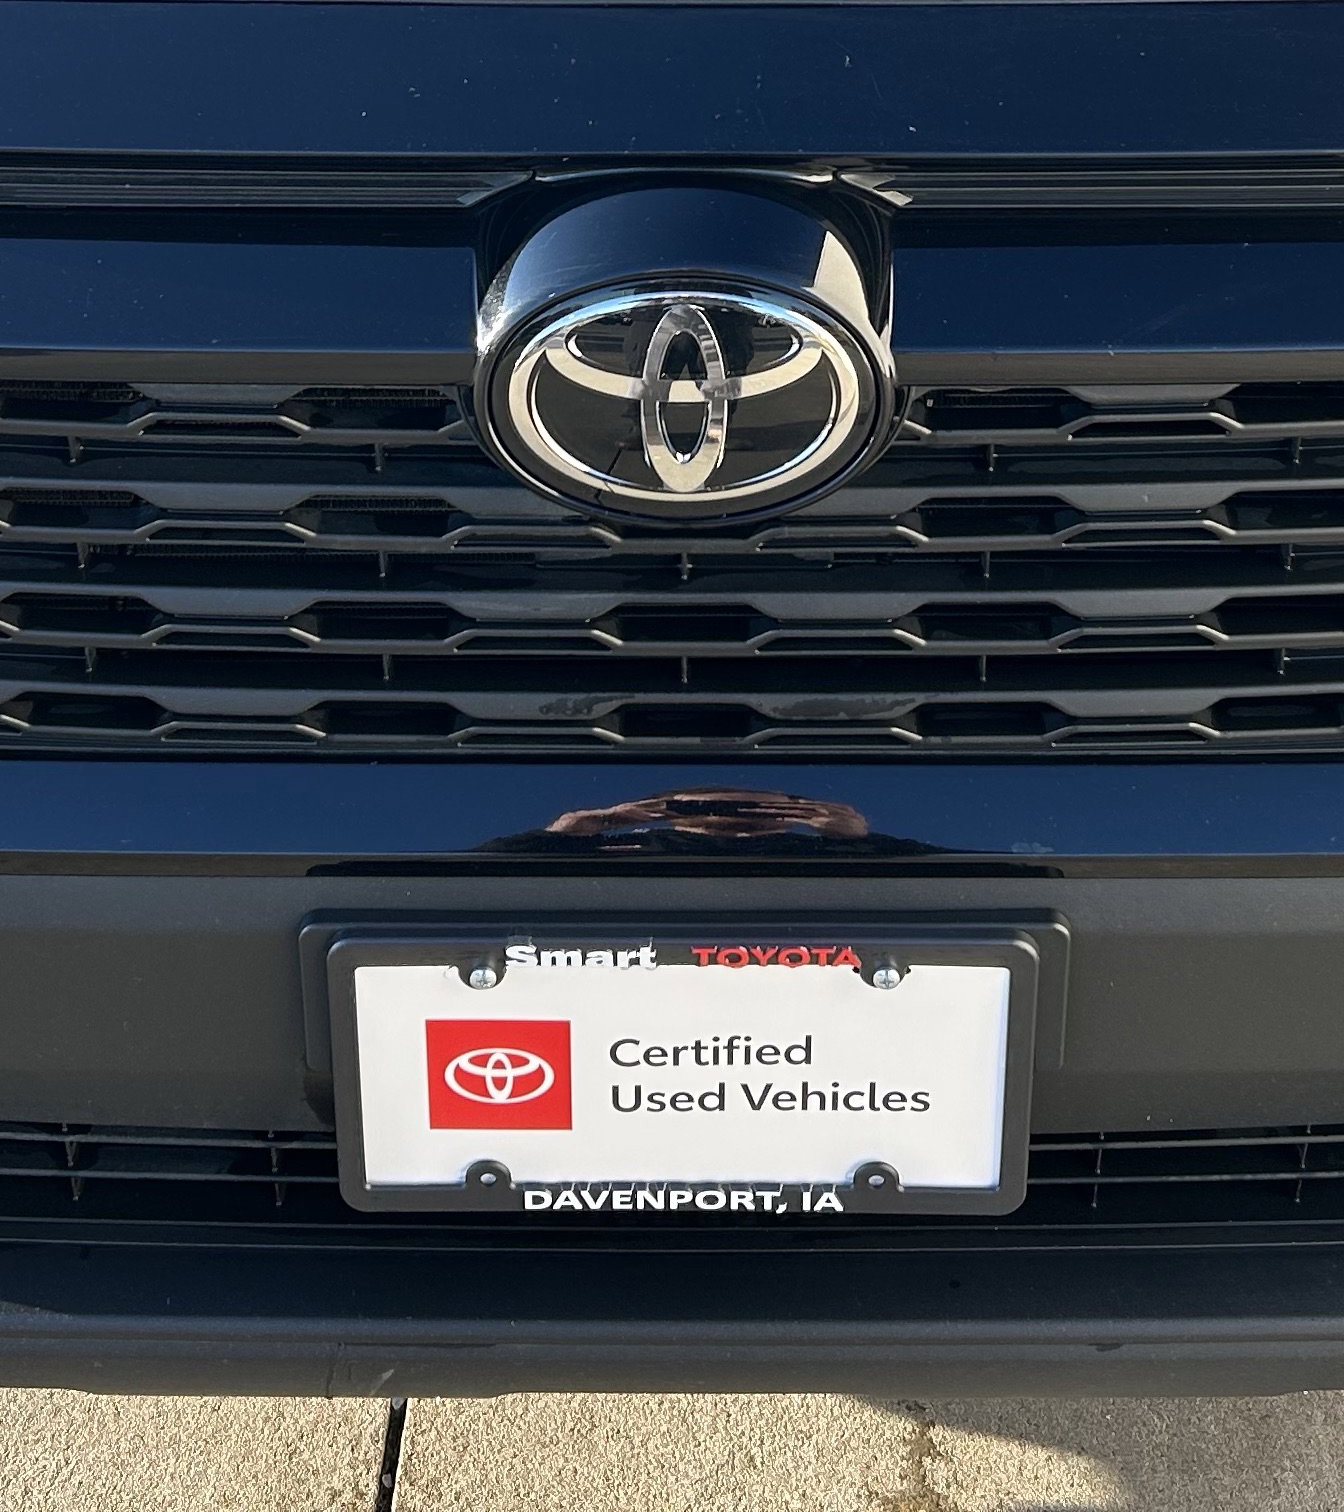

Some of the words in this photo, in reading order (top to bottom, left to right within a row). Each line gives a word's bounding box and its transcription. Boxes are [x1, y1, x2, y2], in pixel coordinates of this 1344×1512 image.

[504, 942, 658, 970] Smart
[690, 945, 863, 970] TOYOTA
[608, 1035, 814, 1068] Certified
[609, 1083, 727, 1114] Used
[740, 1081, 932, 1114] Vehicles
[522, 1189, 791, 1216] DAVENPORT,
[800, 1189, 845, 1213] IA
